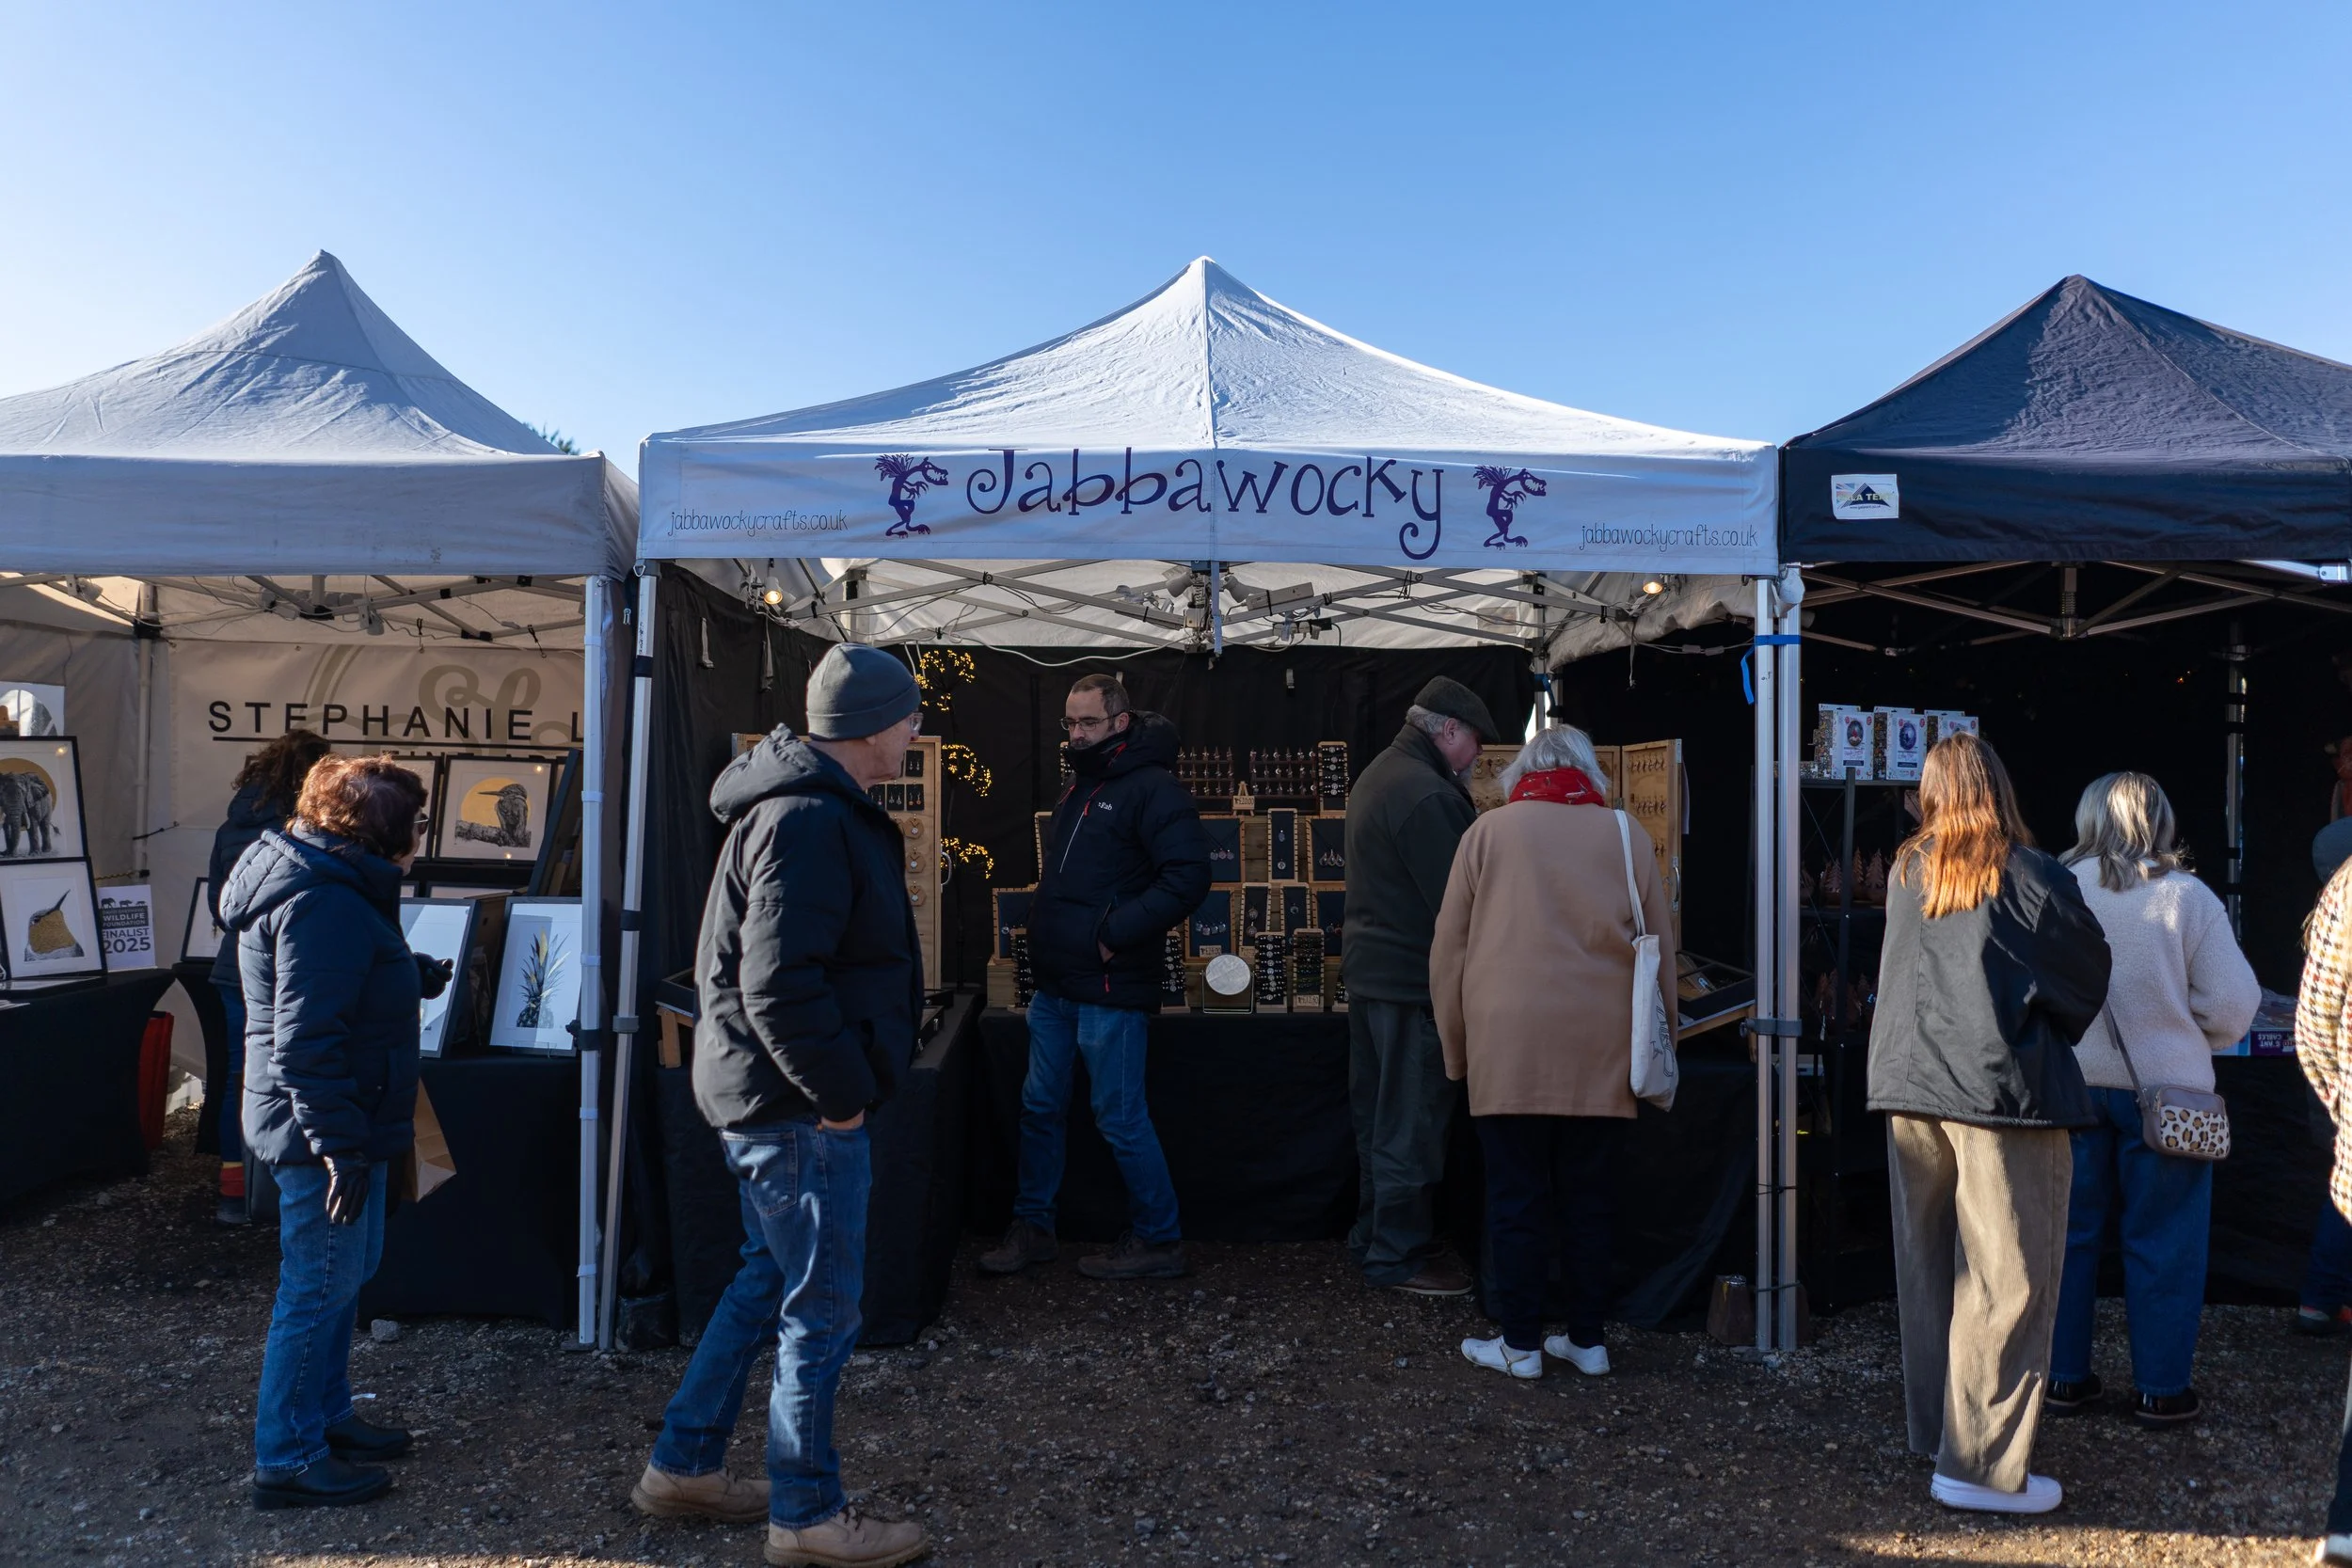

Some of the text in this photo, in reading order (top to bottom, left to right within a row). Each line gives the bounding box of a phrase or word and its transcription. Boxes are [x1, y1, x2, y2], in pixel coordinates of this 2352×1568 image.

[966, 447, 1444, 560] Jabbawocky
[668, 508, 848, 537] jabbawockycrafts.co.uk
[1580, 523, 1758, 552] jabbawockycrafts.co.uk
[208, 700, 532, 741] STEPHANIE
[103, 912, 145, 922] WILDLIFE
[102, 927, 150, 939] FINALIST
[103, 937, 151, 954] 2025
